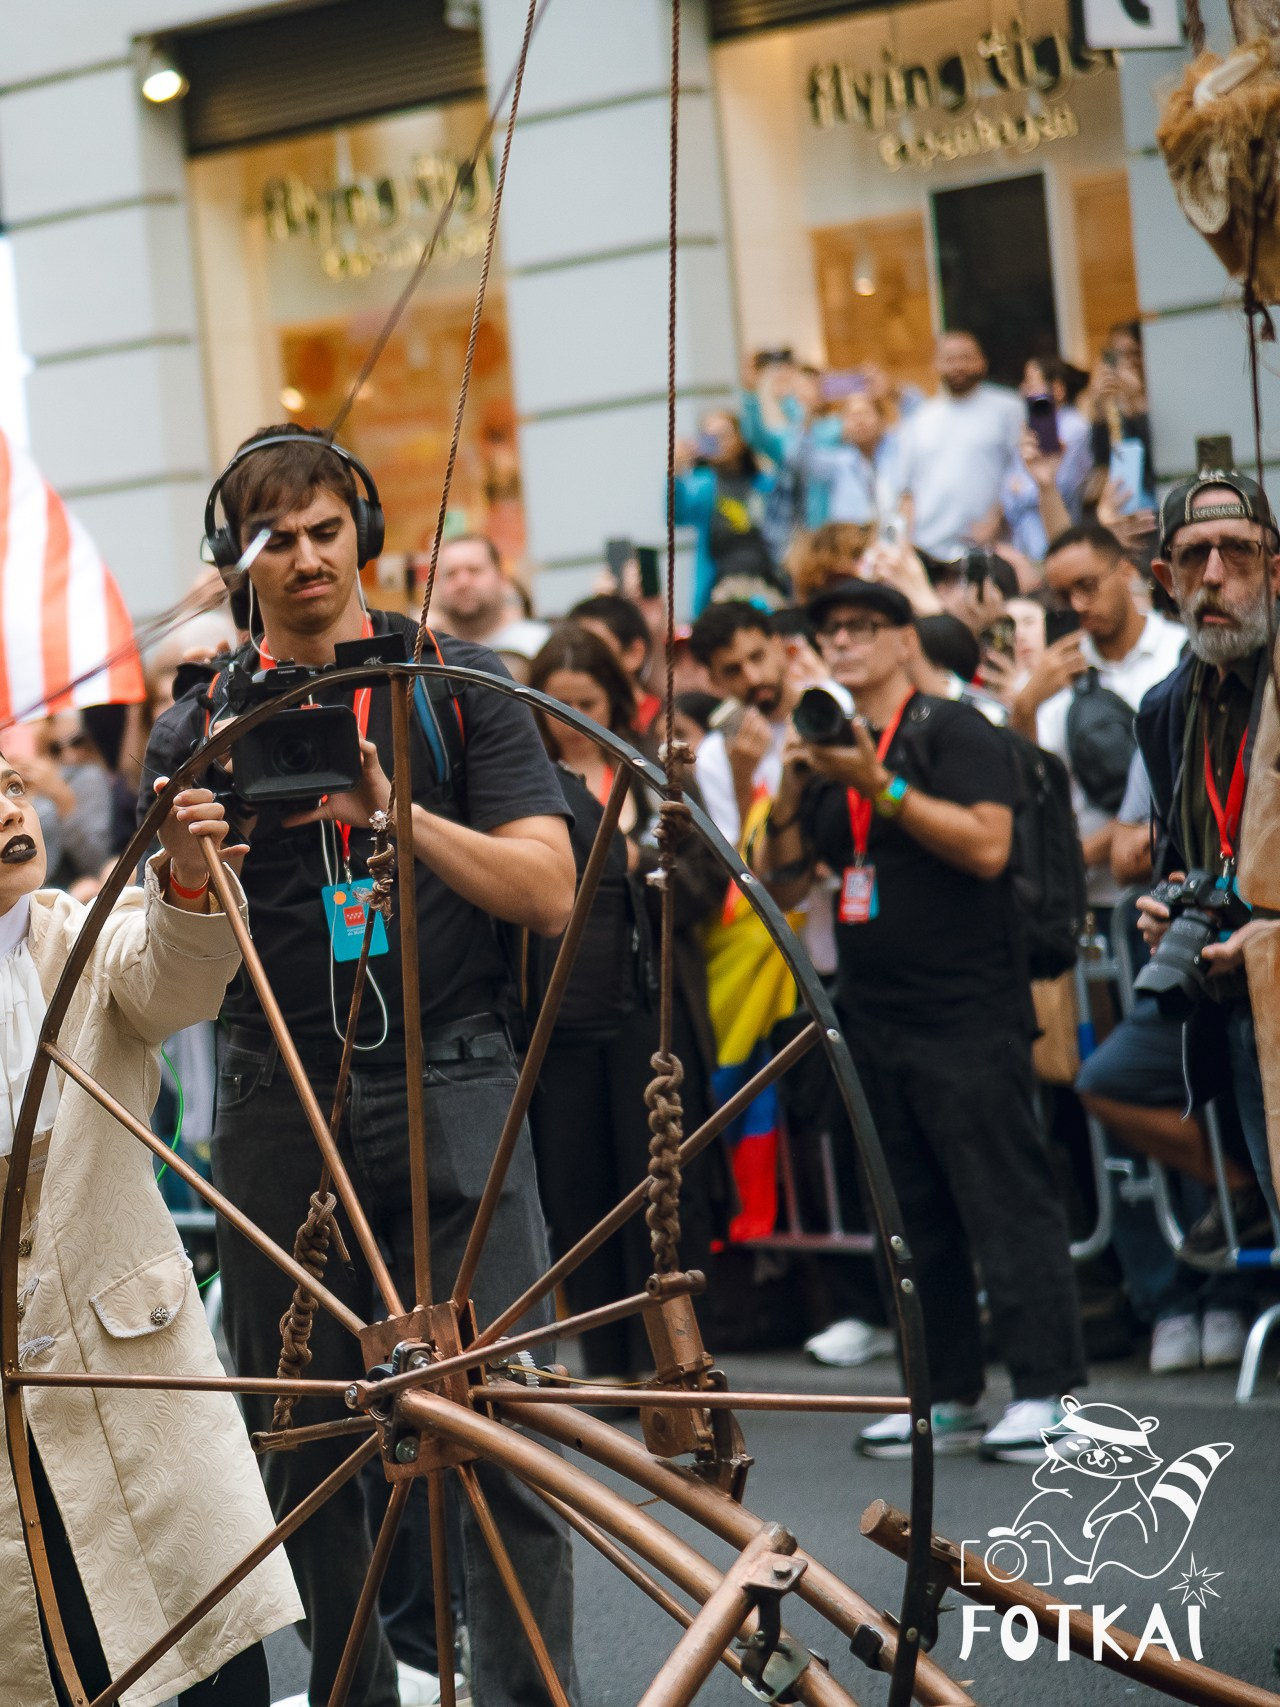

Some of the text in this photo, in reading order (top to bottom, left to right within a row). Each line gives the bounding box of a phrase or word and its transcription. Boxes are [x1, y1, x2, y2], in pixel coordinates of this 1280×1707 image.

[807, 18, 1119, 138] flying tig
[363, 656, 382, 666] 4K
